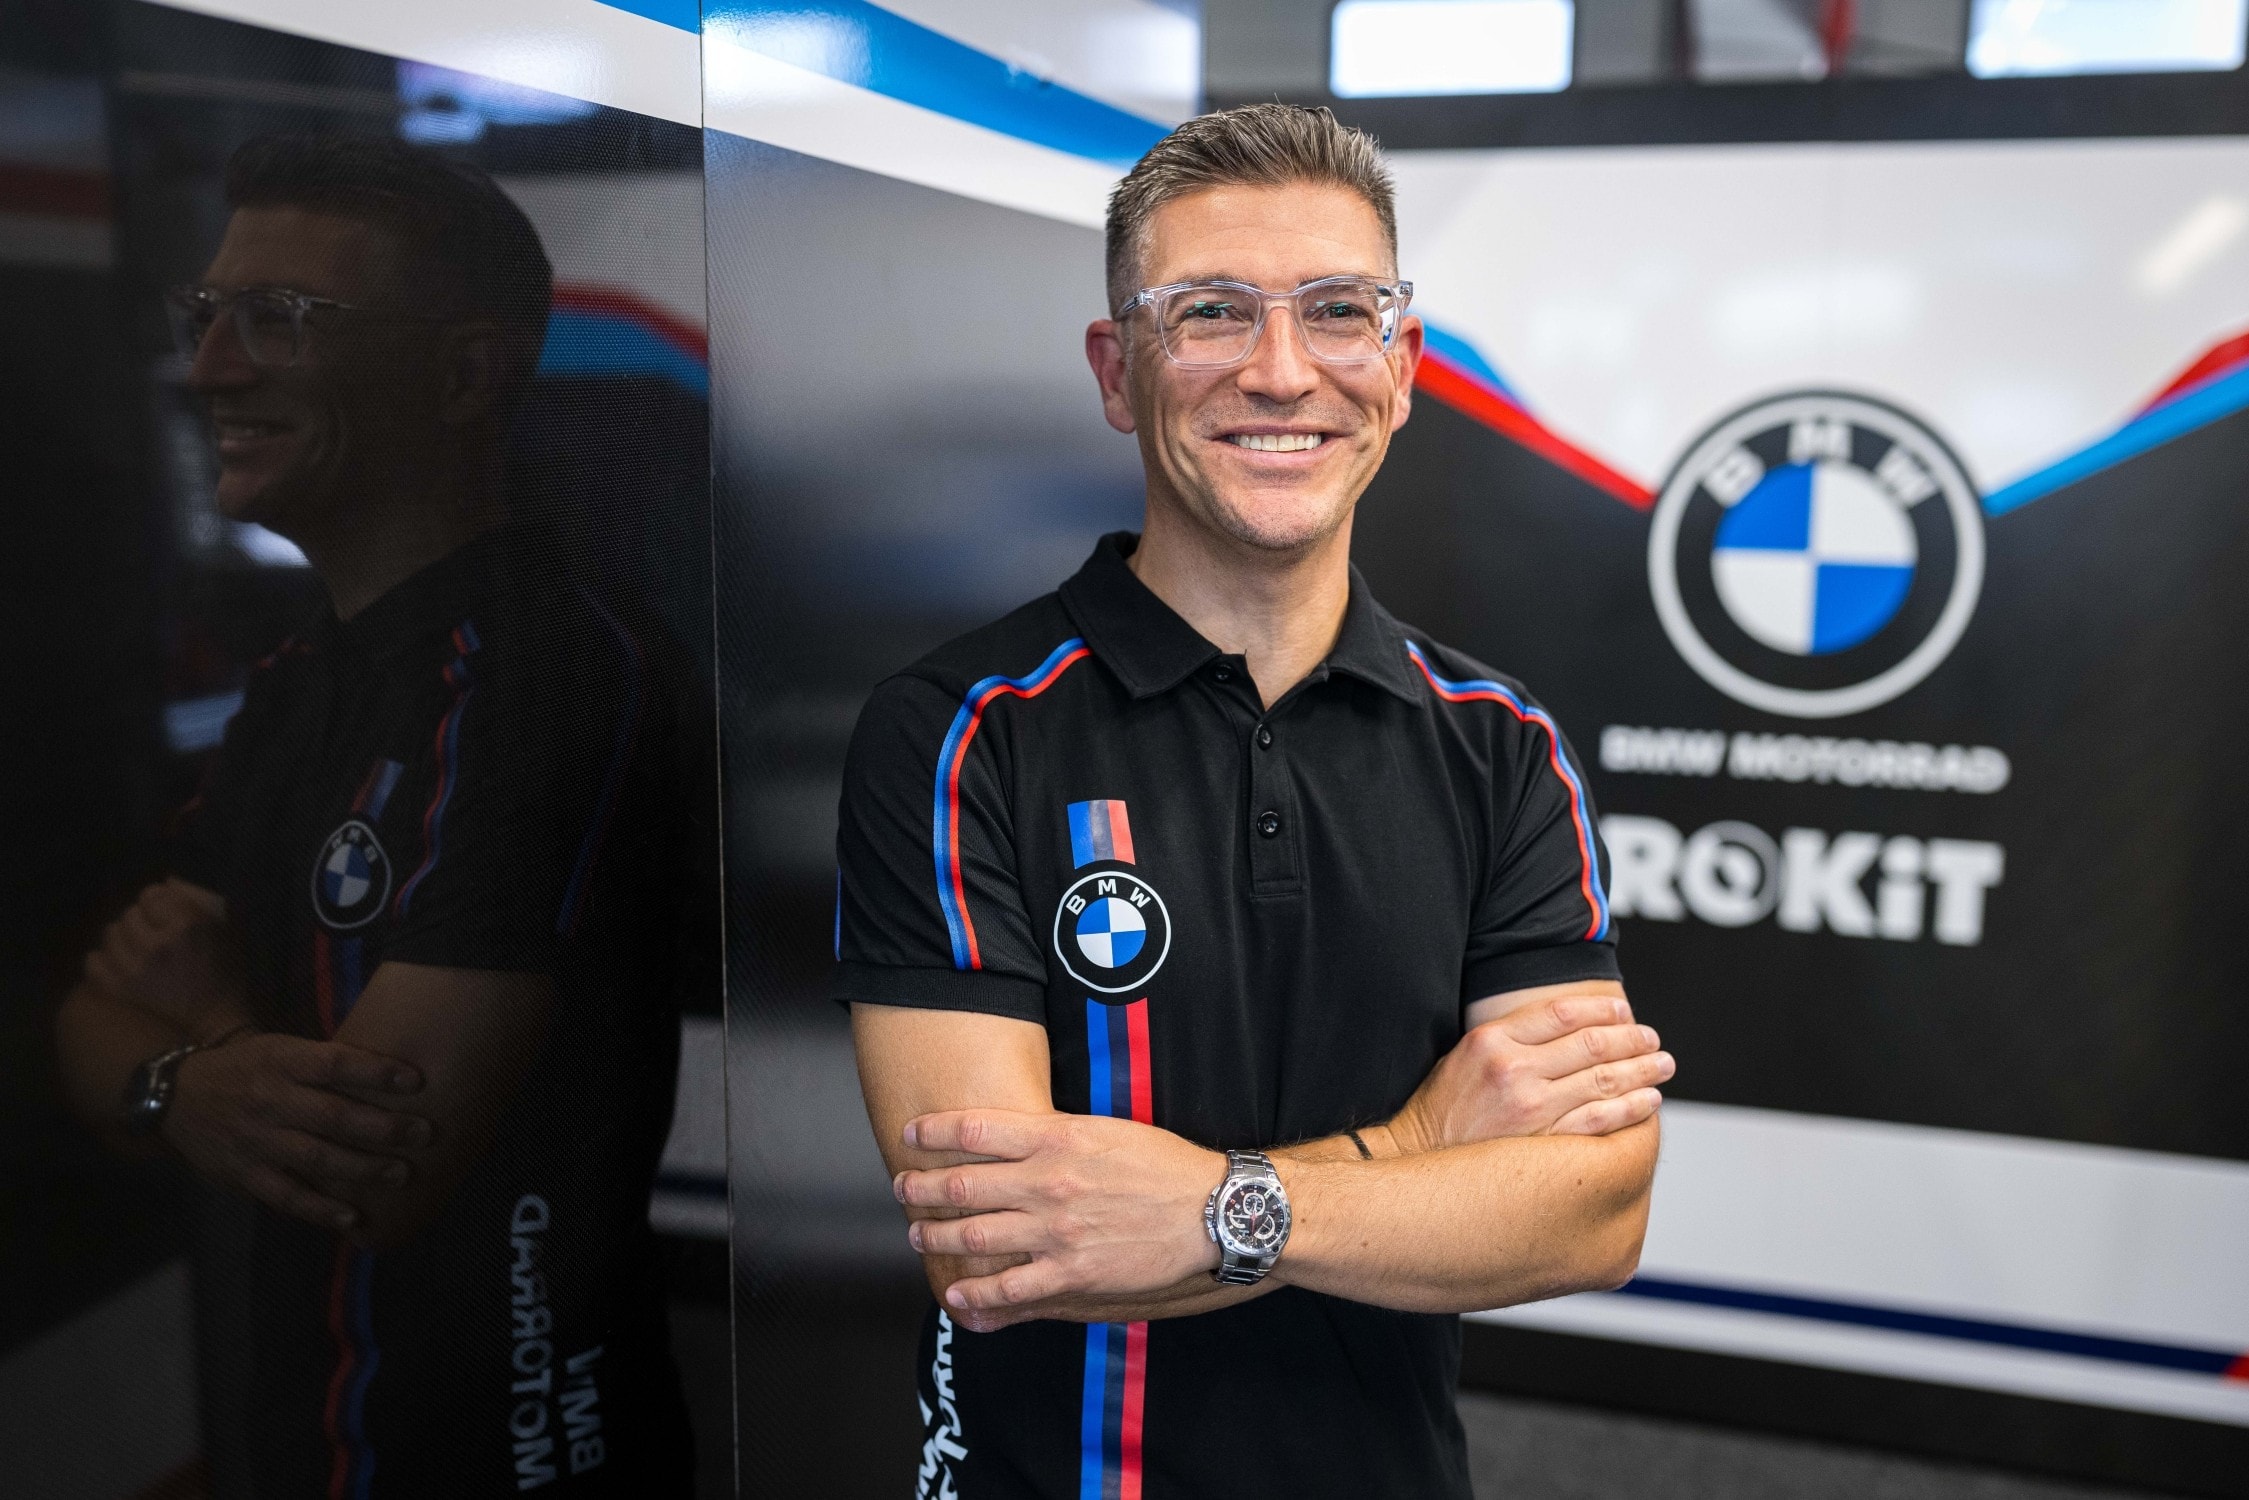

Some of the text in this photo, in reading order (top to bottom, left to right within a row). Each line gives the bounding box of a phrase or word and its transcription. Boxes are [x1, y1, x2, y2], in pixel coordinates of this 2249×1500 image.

[1701, 420, 1941, 508] BMW
[1600, 724, 2012, 794] BMW MOTORRAD
[1066, 878, 1151, 916] BMW
